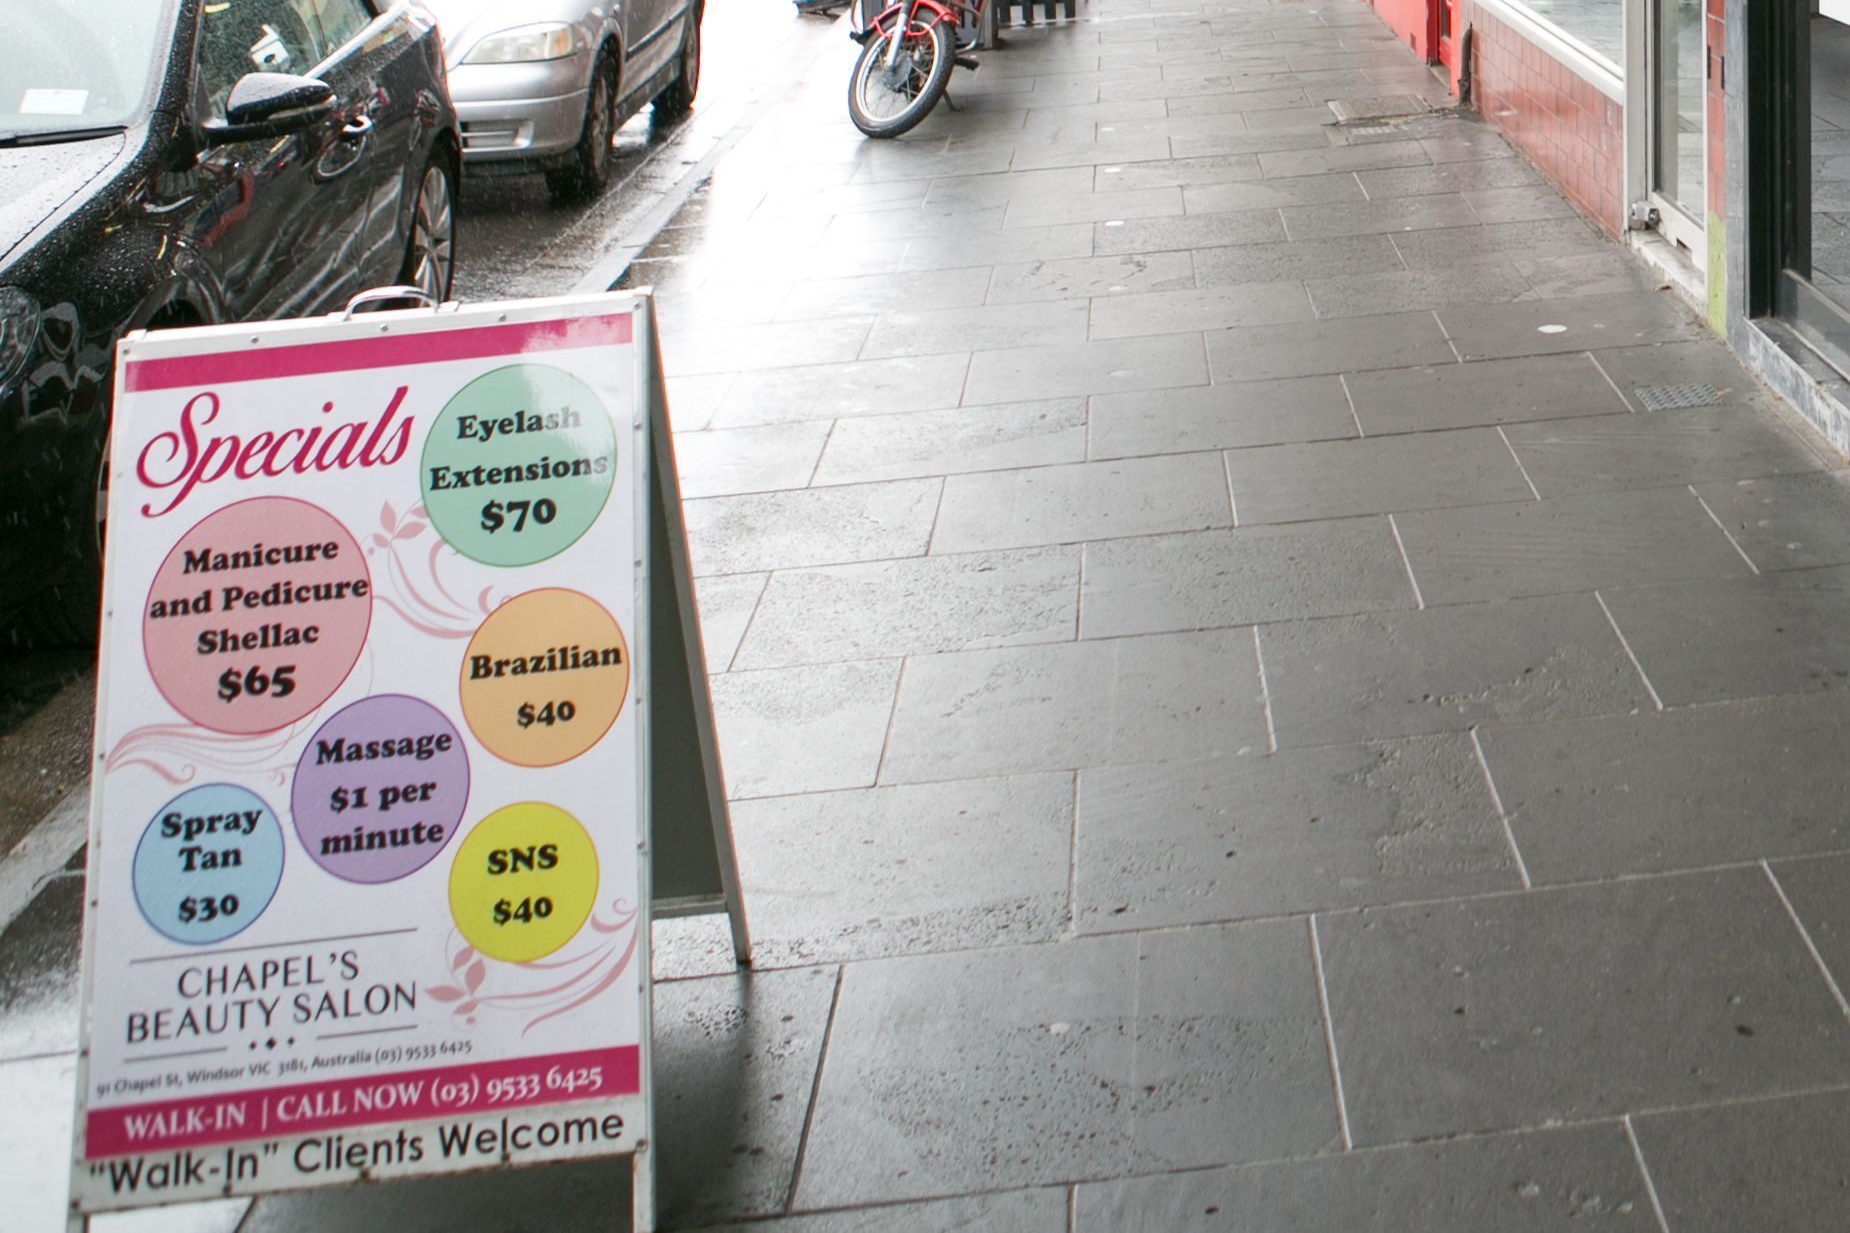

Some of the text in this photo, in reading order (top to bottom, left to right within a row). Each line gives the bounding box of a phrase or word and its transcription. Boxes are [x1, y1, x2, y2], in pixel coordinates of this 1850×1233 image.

[456, 405, 581, 442] Eyelash
[136, 385, 416, 519] Specials
[430, 452, 609, 492] Extensions
[480, 497, 558, 534] $70
[182, 538, 339, 575] Manicure
[149, 575, 370, 620] and Pedicure
[196, 620, 320, 657] Shellac
[469, 642, 622, 681] Brazilian
[217, 665, 297, 704] $65
[516, 699, 576, 729] $40
[315, 730, 453, 769] Massage
[330, 780, 438, 814] $1 per
[160, 806, 263, 839] Spray
[319, 820, 445, 856] minute
[178, 845, 243, 874] Tan
[487, 844, 560, 876] SNS
[177, 893, 240, 925] $30
[492, 897, 554, 926] $40
[177, 951, 360, 999] CHAPEL'S
[126, 981, 417, 1045] BEAUTY SALON
[95, 1039, 472, 1098] 91 Chapel St, Windsor VIC 3181, Australia (03) 9533 6425
[123, 1064, 603, 1142] WALK-IN CALL NOW (03) 9533 6425
[89, 1113, 624, 1194] "Walk-In" Clients Welcome
